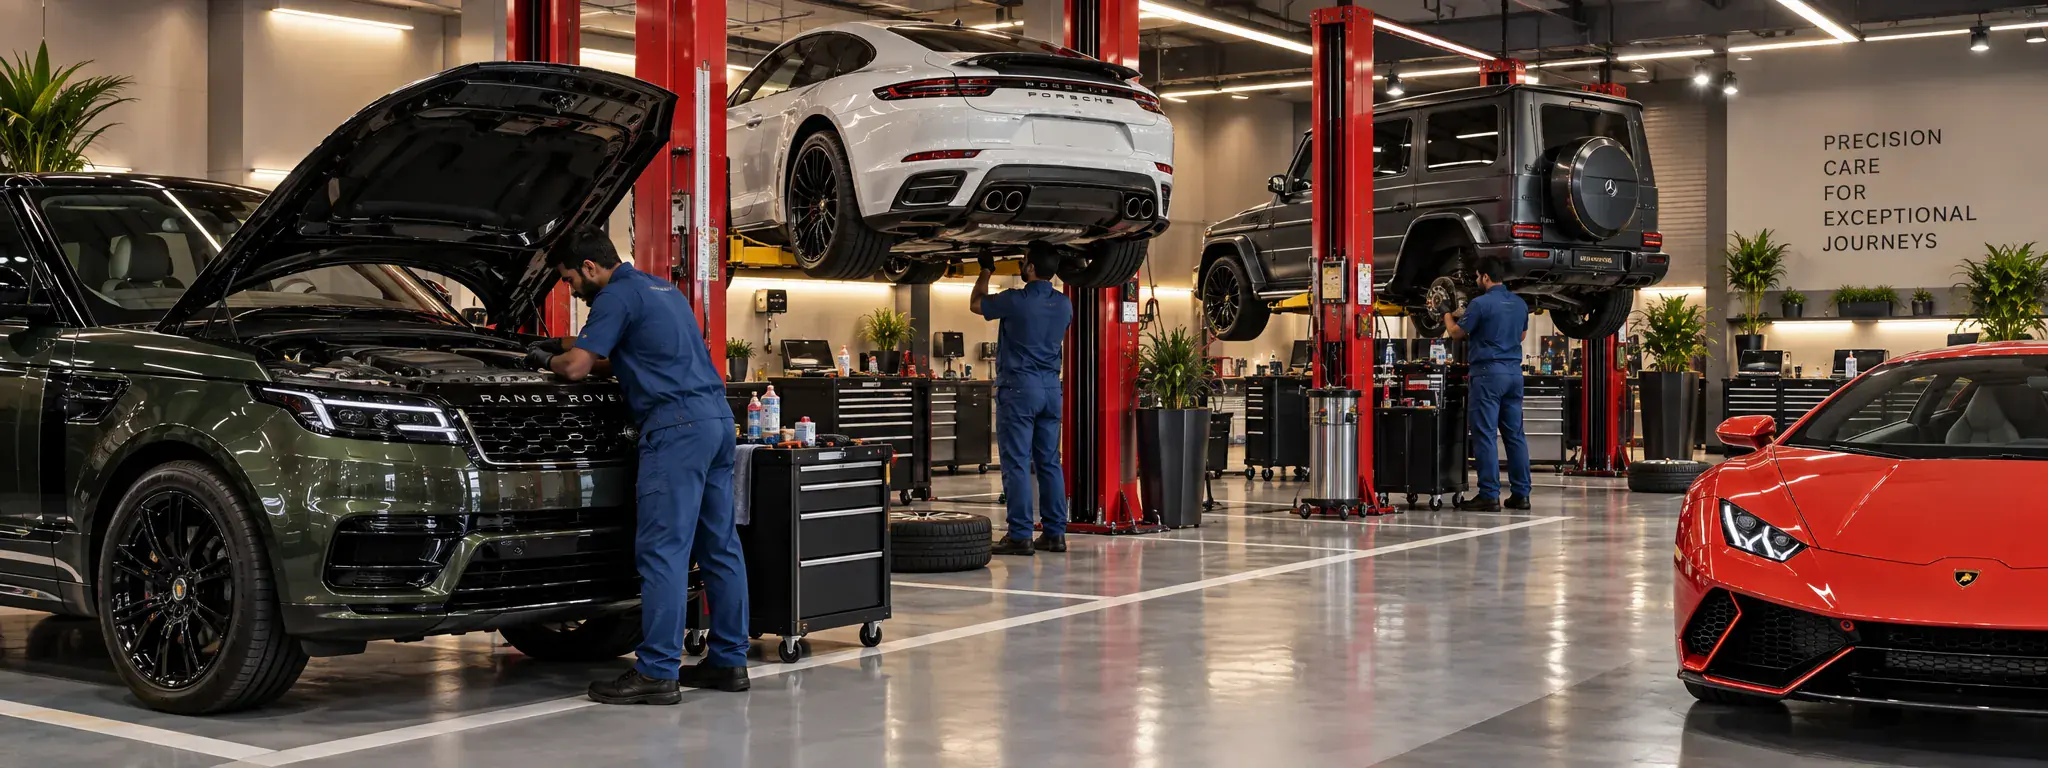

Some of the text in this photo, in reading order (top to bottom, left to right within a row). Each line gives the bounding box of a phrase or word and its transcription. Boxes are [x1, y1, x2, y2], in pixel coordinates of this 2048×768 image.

[1028, 91, 1114, 104] PORSCHE
[1824, 129, 1941, 150] PRECISION
[1823, 158, 1880, 175] CARE
[1824, 184, 1866, 200] FOR
[1824, 205, 1977, 226] EXCEPTIONAL
[1822, 233, 1937, 251] JOURNEYS
[480, 394, 557, 403] RANGE
